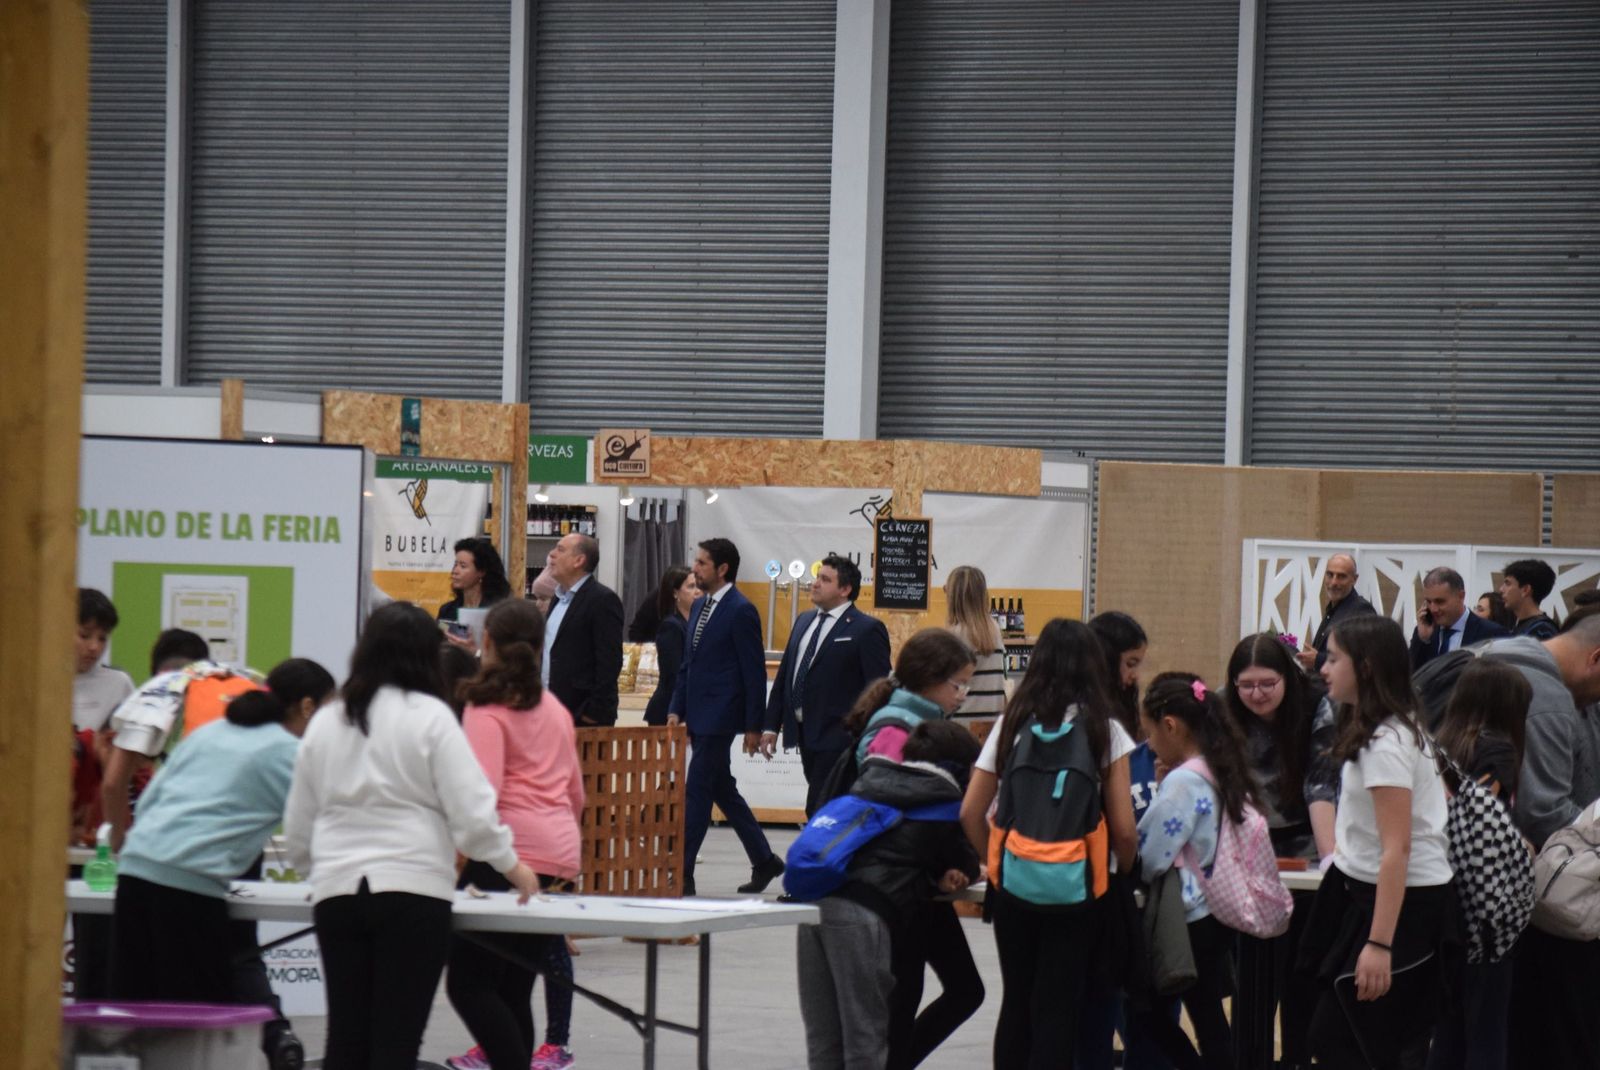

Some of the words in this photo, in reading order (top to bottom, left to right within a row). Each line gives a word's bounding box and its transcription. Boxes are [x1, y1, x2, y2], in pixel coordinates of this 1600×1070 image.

[392, 461, 478, 473] ARTESANALES
[176, 511, 212, 540] DE
[221, 512, 253, 541] LA
[262, 514, 341, 543] FERIA
[880, 521, 926, 534] CERVEZA
[385, 535, 447, 554] BUBELA
